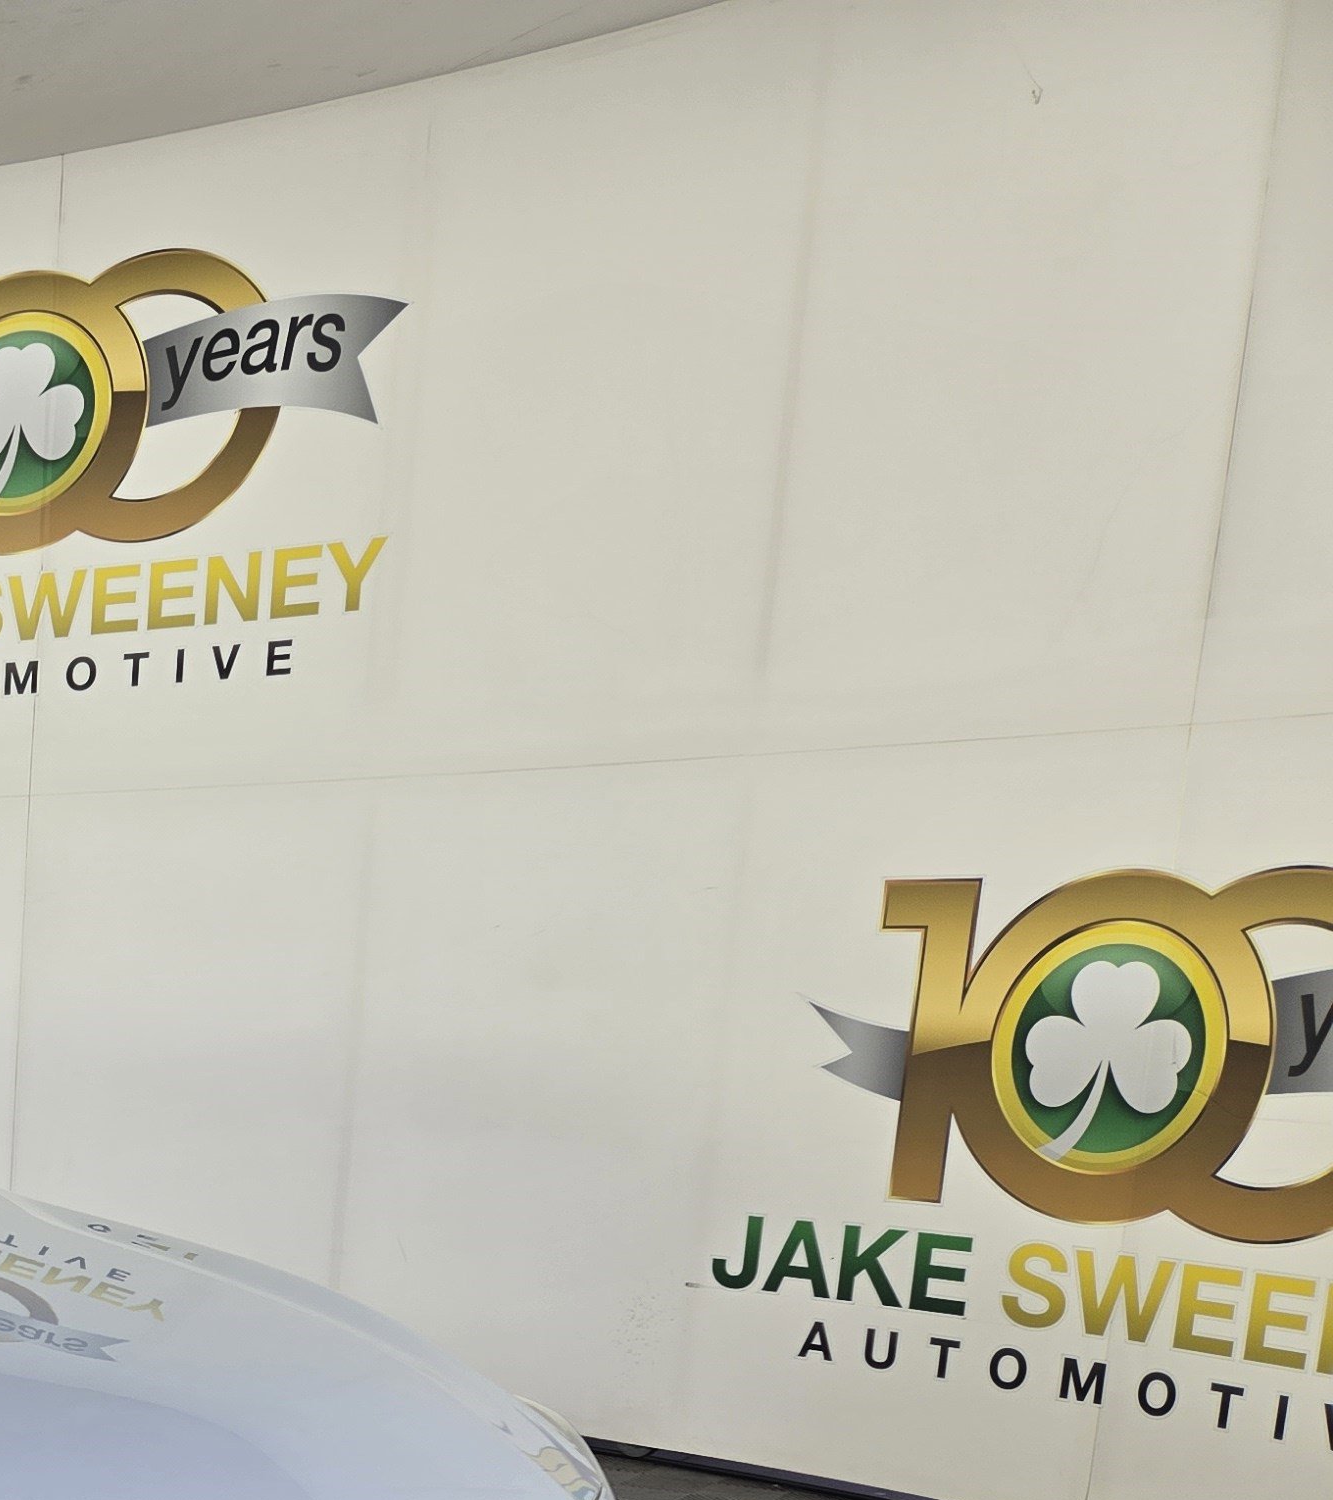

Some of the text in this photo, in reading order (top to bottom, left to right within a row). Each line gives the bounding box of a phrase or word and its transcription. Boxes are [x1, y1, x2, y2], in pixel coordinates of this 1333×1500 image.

[162, 311, 346, 409] years
[712, 1215, 973, 1317] JAKE
[798, 1321, 1333, 1451] AUTOMOTI
